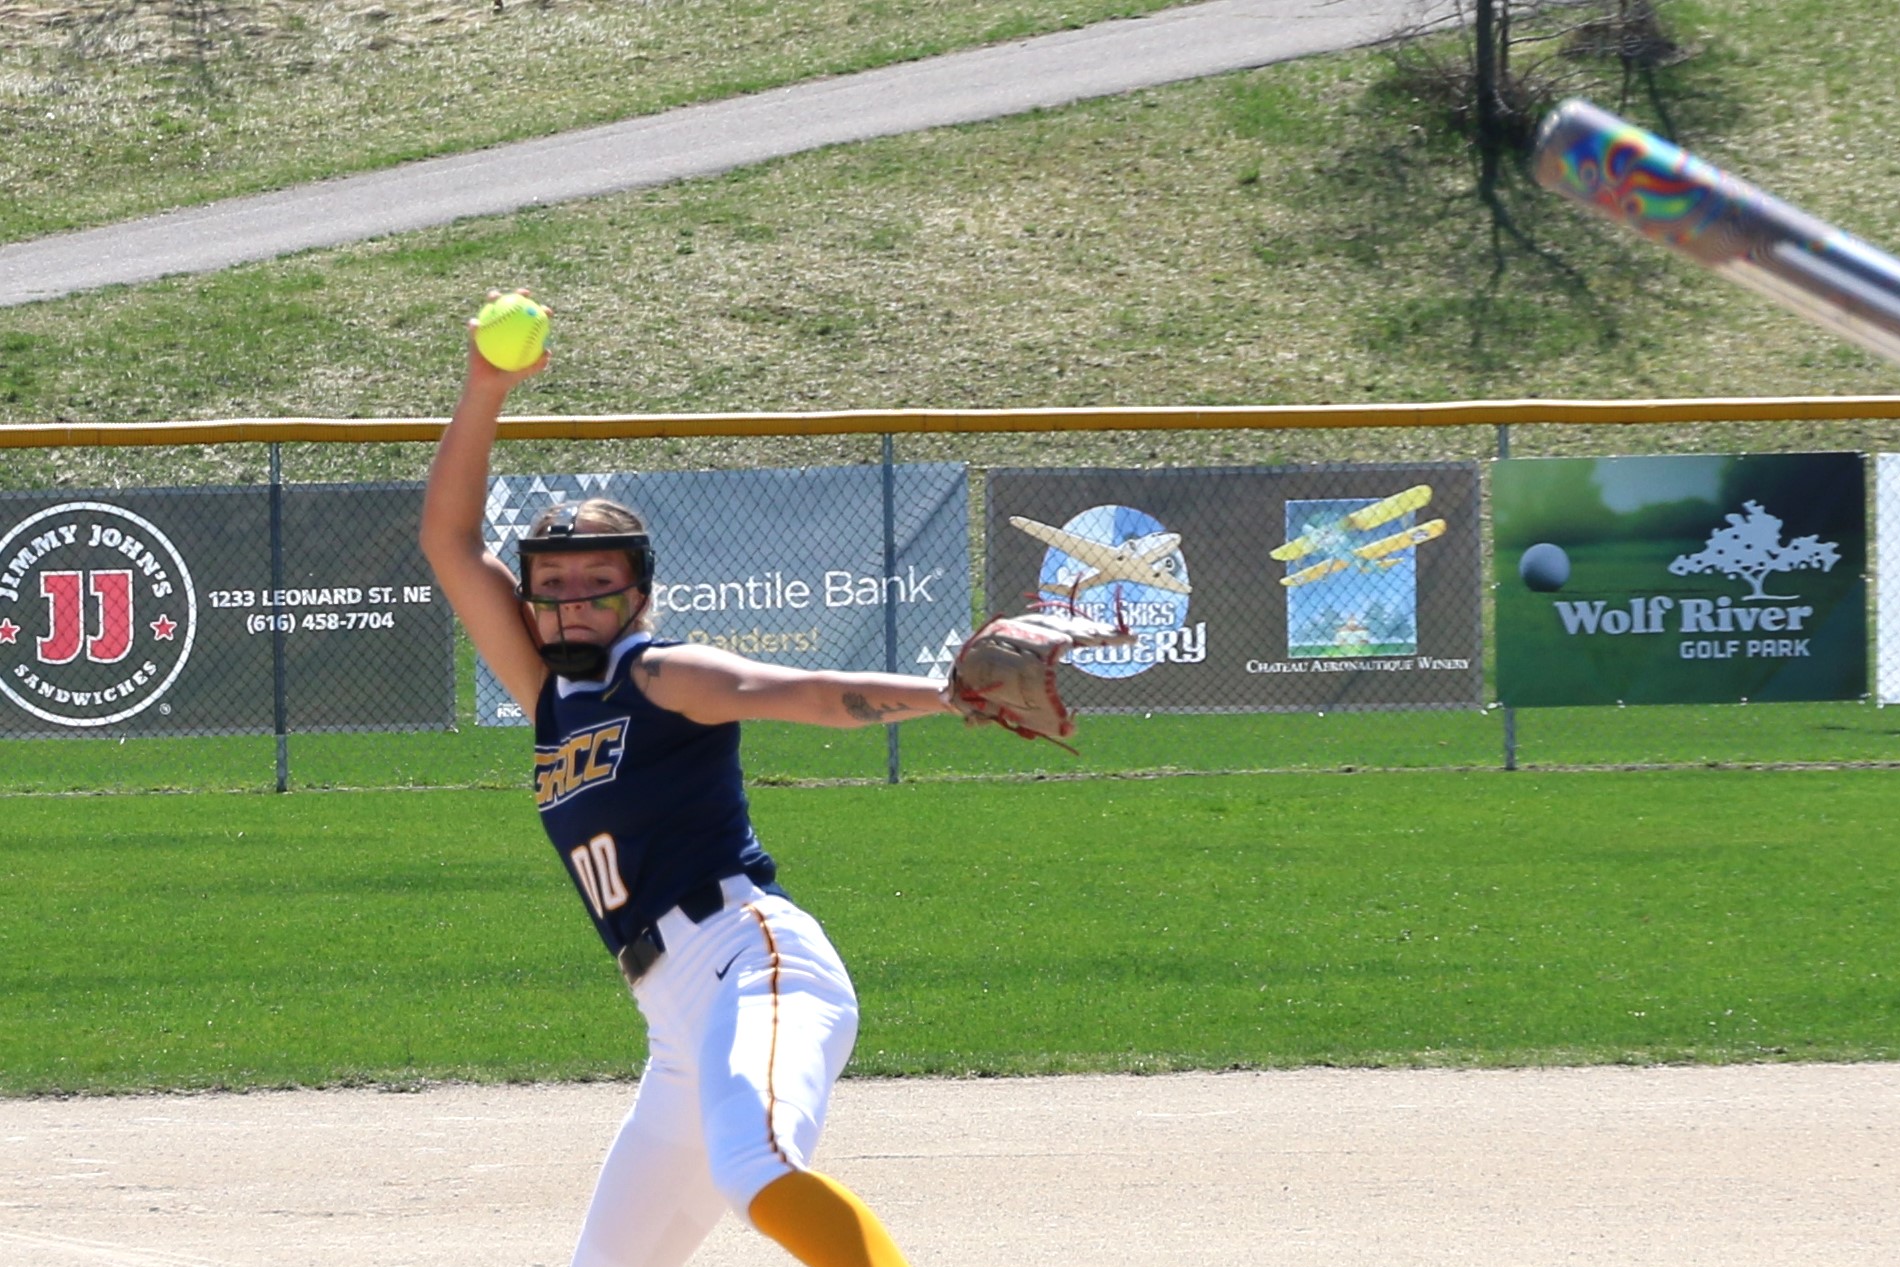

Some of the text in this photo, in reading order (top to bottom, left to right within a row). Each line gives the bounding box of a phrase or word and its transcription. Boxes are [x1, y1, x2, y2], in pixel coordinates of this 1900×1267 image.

[0, 524, 172, 602] JIMMY JOHN'S
[208, 585, 432, 608] 1233 LEONARD ST. NE
[652, 565, 933, 612] rcantile Bank
[36, 569, 133, 664] JJ
[246, 611, 395, 634] (616) 458-7704
[1554, 596, 1814, 635] Wolf River
[1680, 638, 1810, 660] GOLF PARK
[14, 660, 157, 706] SANDWICHES
